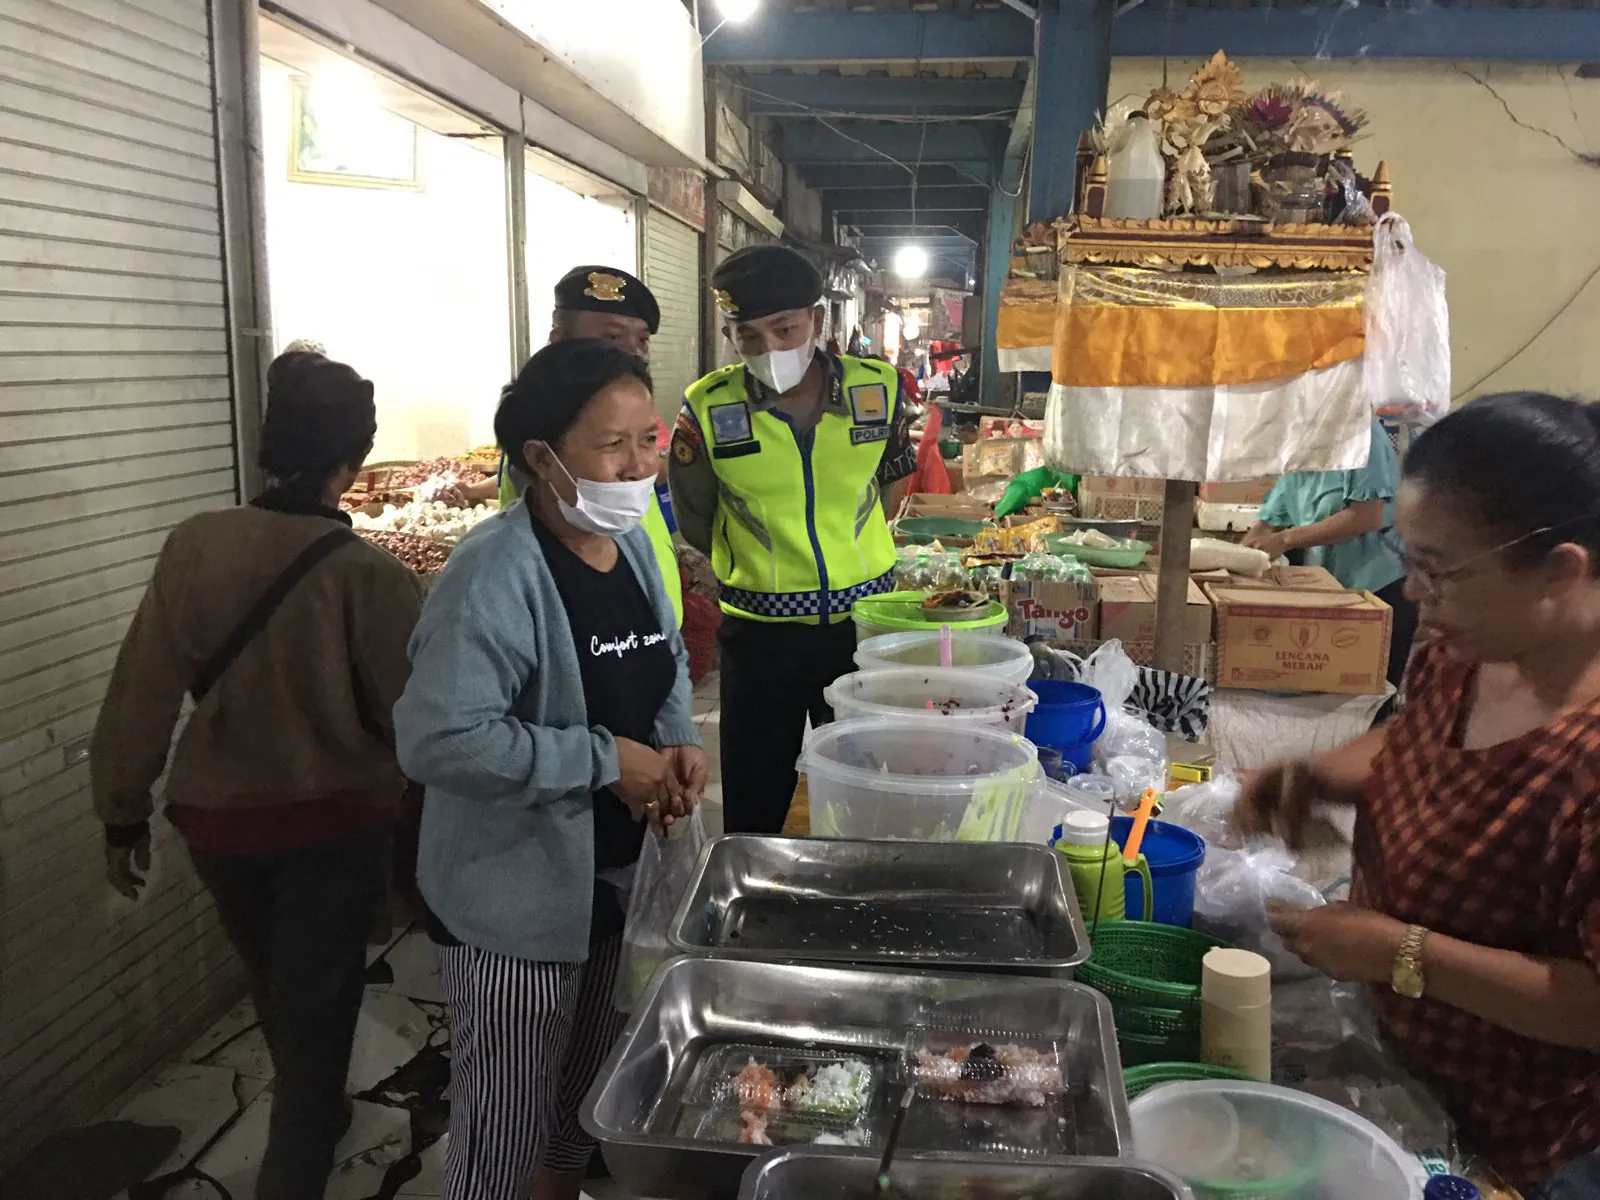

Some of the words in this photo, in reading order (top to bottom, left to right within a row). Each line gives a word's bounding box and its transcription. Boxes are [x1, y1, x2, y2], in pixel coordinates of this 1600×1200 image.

[1017, 599, 1090, 630] Tango
[590, 630, 639, 658] Comfort
[1275, 651, 1331, 662] LENCANA
